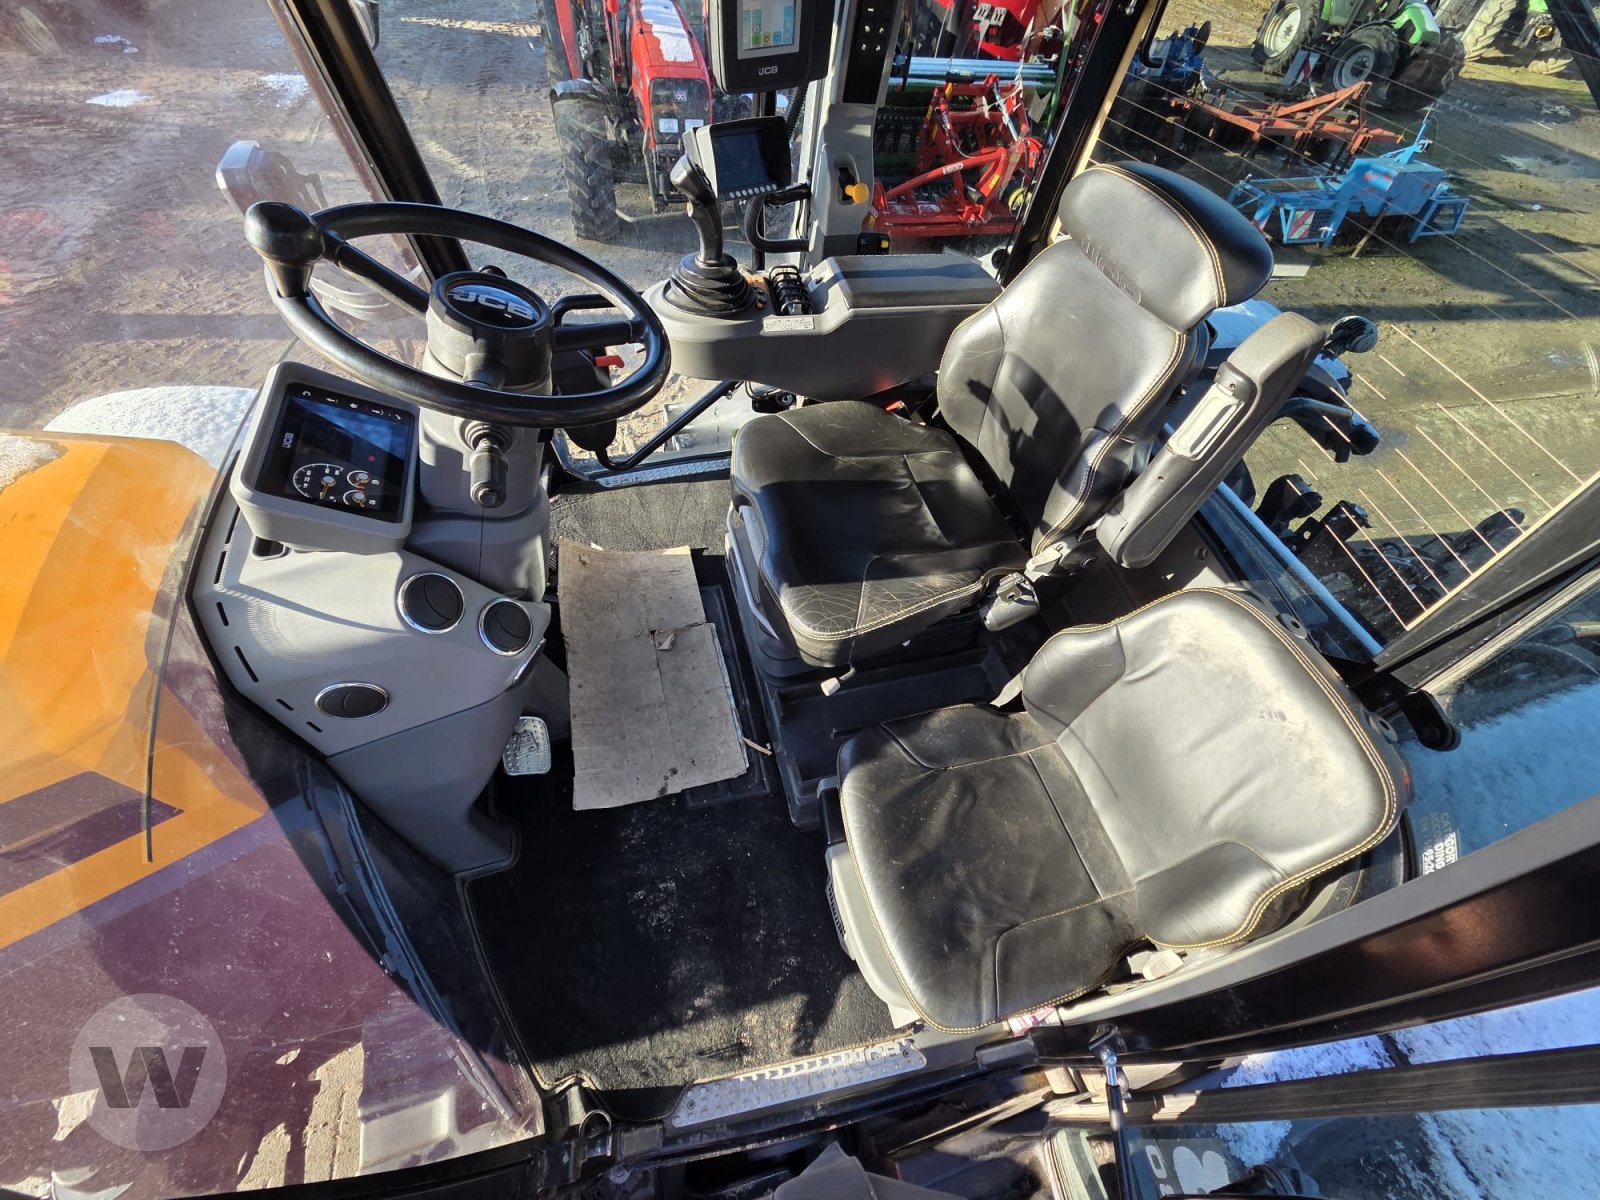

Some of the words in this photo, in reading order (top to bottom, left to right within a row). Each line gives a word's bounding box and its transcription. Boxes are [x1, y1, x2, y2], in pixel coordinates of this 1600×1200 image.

[758, 65, 779, 76] JCB
[450, 290, 536, 321] JCB
[281, 432, 294, 449] JCB
